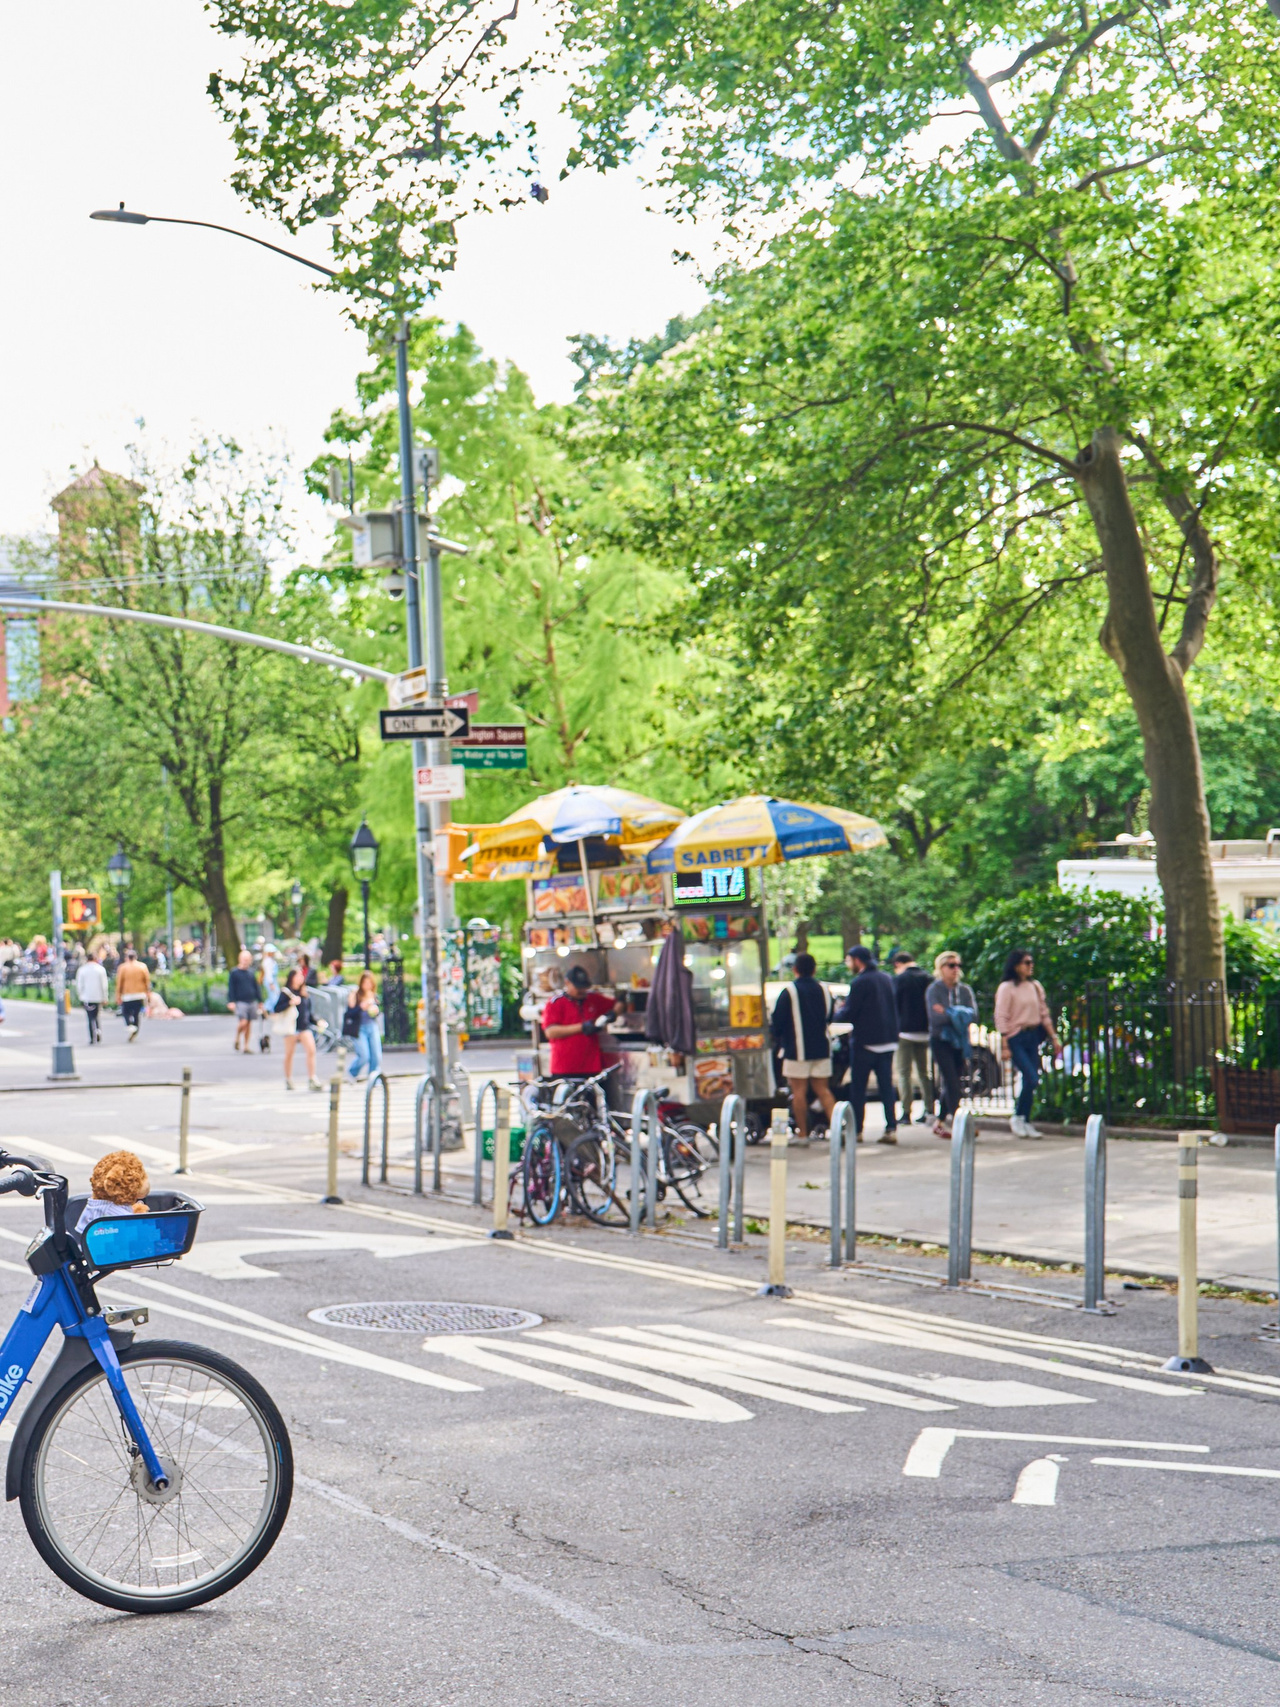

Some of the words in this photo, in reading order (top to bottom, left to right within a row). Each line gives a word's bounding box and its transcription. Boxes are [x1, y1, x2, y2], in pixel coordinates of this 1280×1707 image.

[392, 718, 419, 732] ONE
[430, 717, 456, 731] WAY
[470, 730, 494, 743] ington
[497, 729, 524, 742] Square
[681, 845, 768, 867] SABRETT
